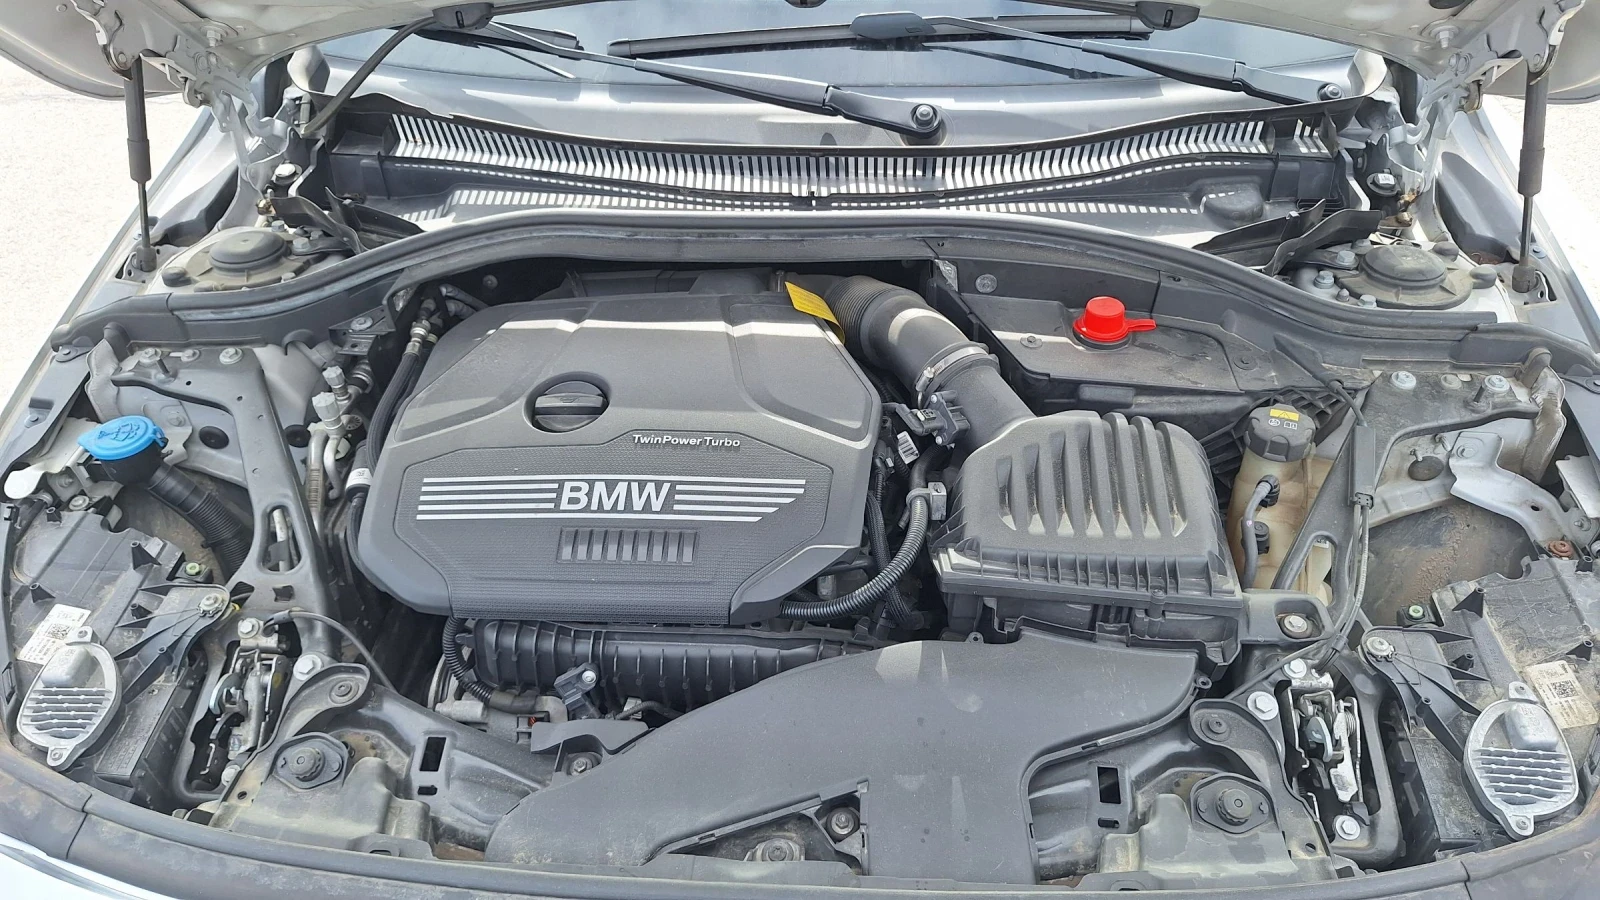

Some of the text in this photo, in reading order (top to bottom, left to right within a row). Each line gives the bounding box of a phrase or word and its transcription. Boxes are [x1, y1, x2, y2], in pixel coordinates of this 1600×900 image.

[632, 434, 740, 447] TwinPower Turbo
[559, 481, 671, 512] BMW
